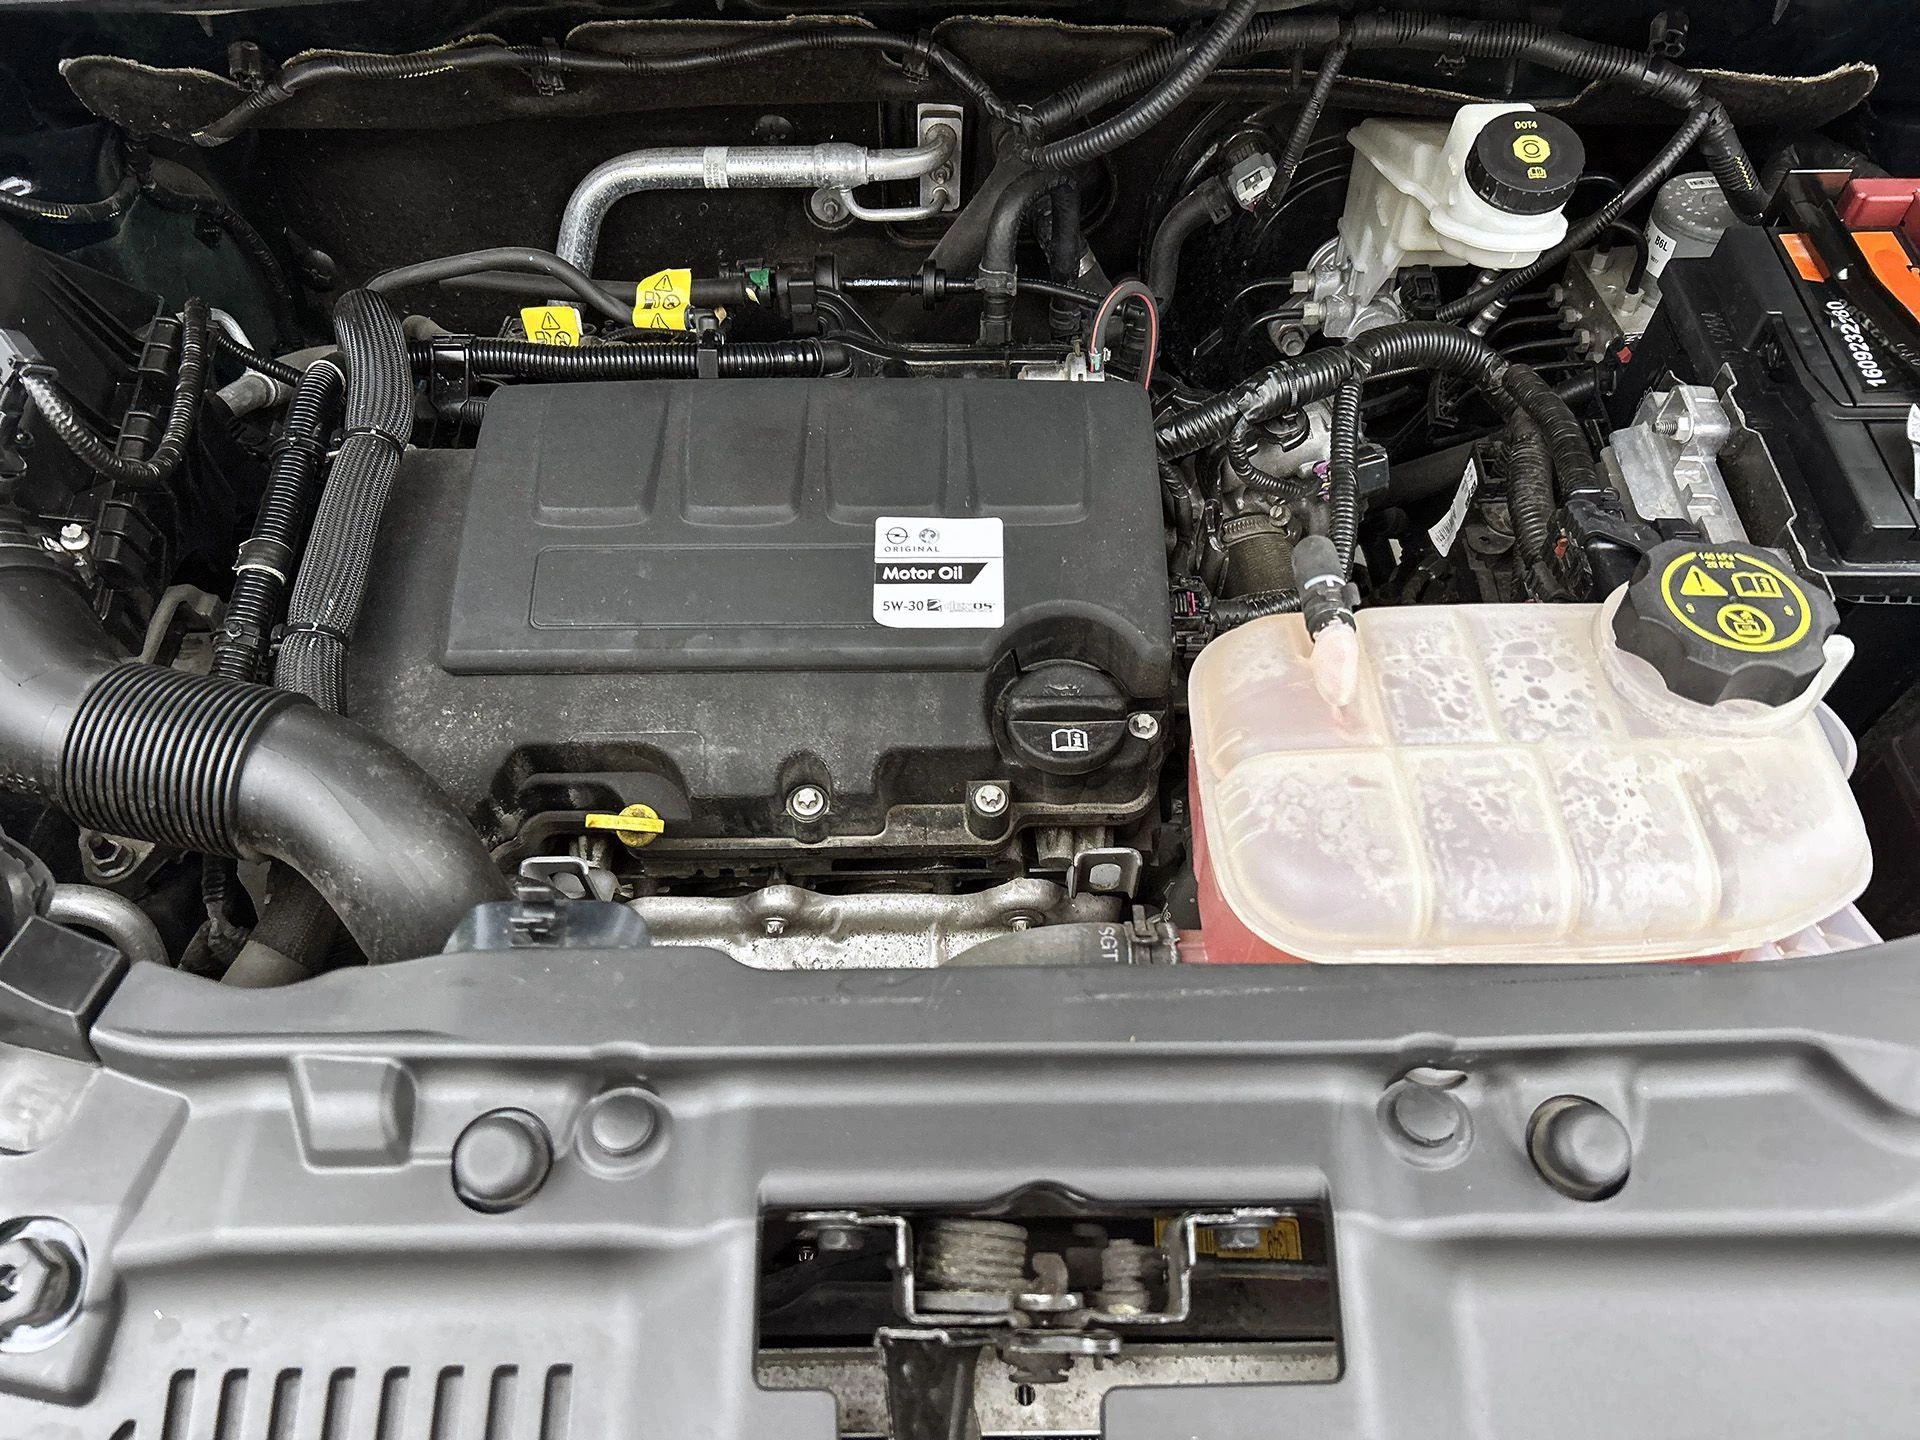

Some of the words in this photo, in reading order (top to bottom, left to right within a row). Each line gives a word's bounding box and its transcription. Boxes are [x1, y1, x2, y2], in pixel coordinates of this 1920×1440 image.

[1514, 120, 1538, 130] DOT4
[882, 566, 936, 580] Motor
[938, 565, 963, 580] Oil
[882, 600, 924, 611] 5W-30
